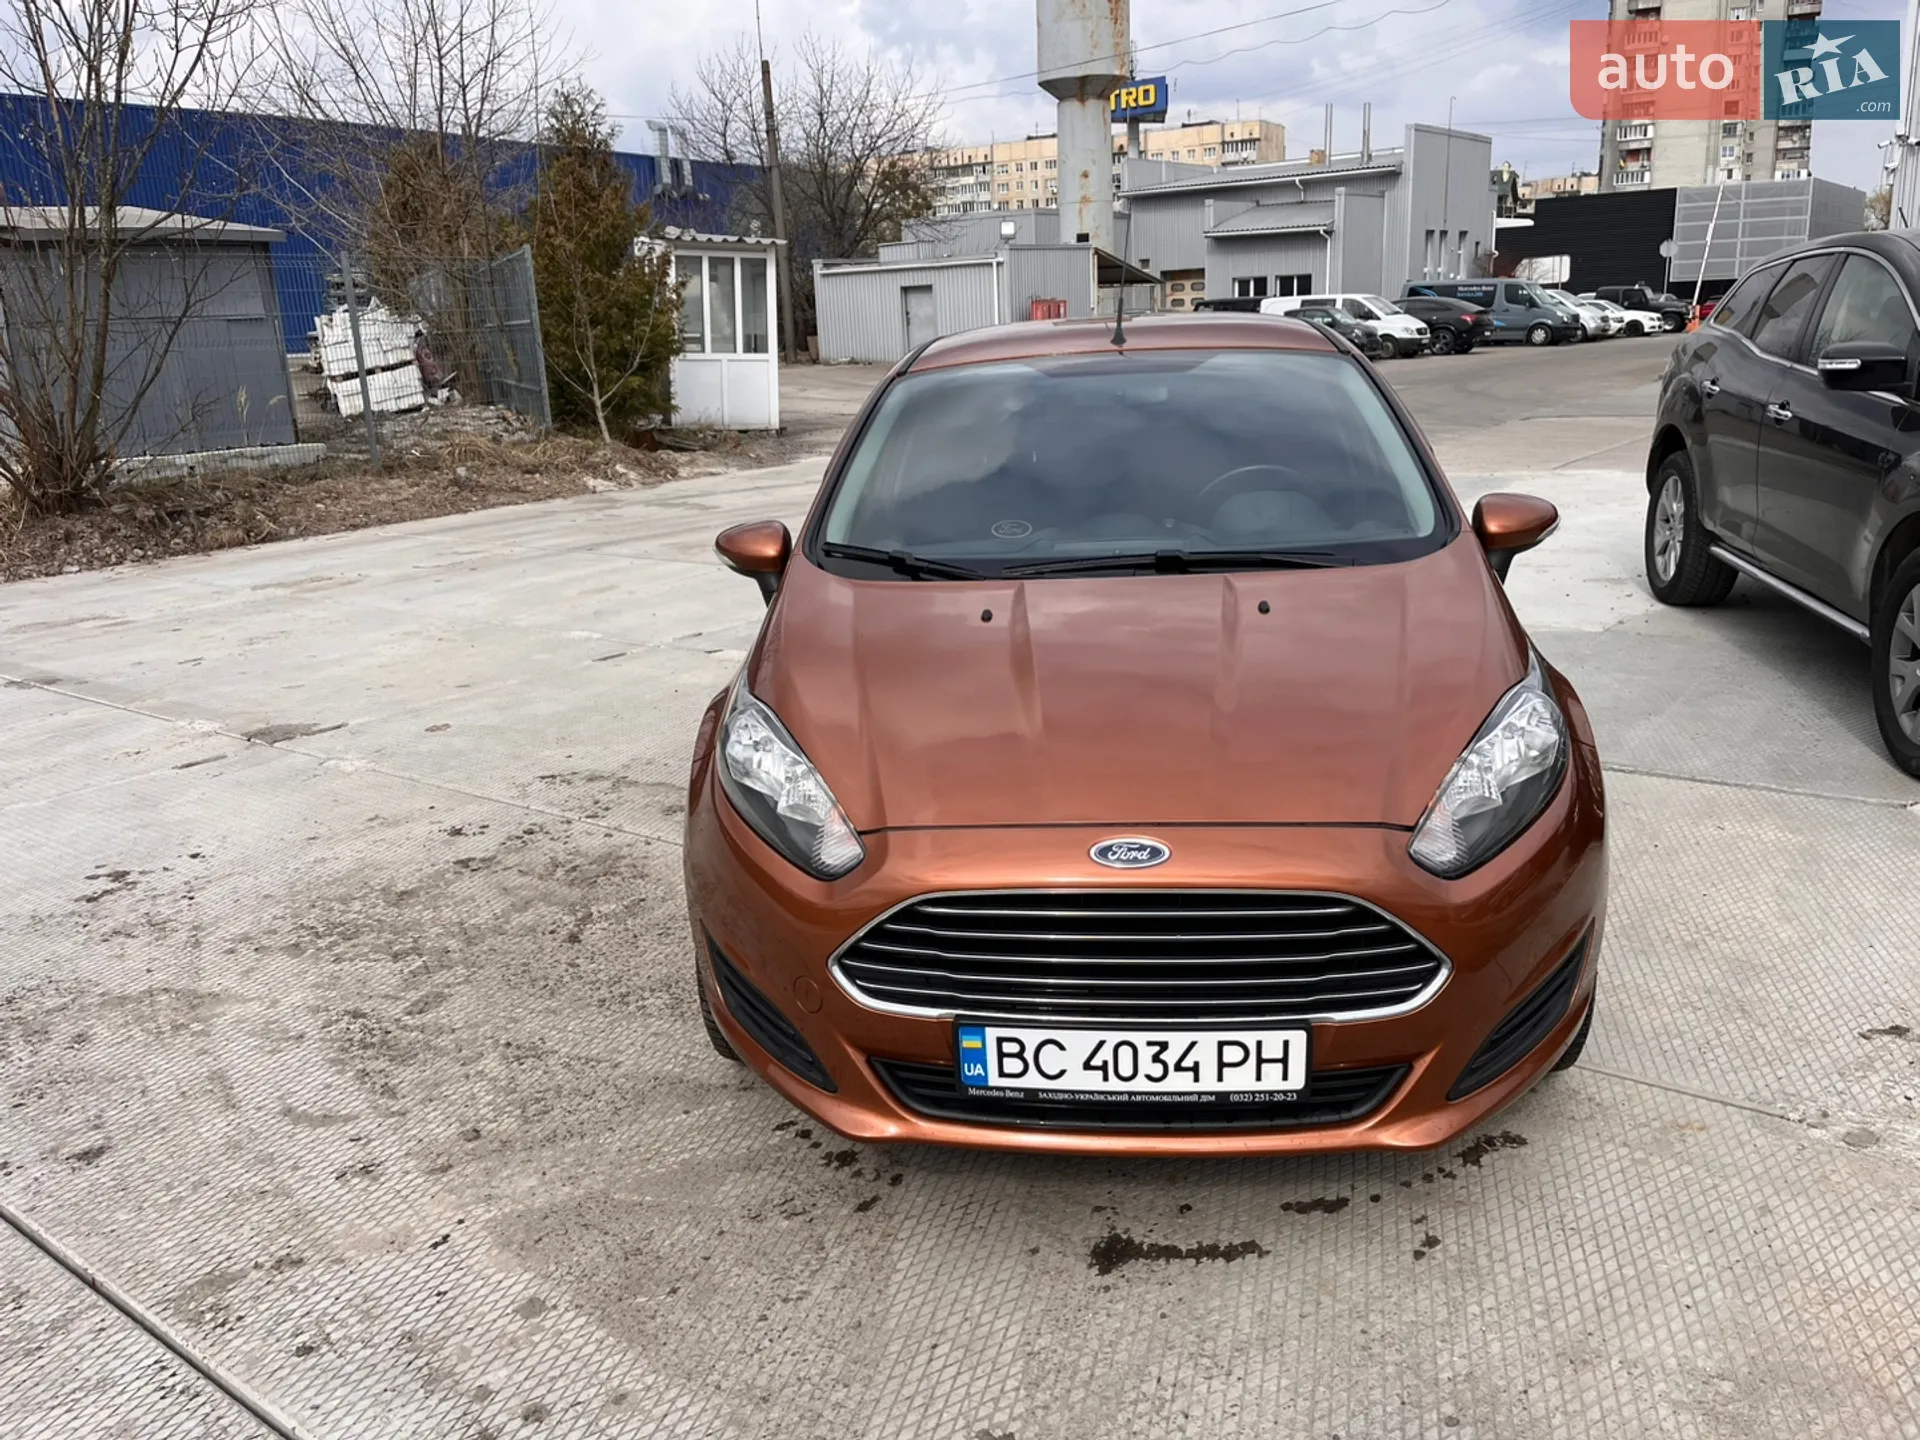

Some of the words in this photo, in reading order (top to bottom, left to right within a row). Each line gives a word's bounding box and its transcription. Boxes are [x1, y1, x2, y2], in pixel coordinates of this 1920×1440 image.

[1107, 842, 1151, 860] Ford
[995, 1036, 1067, 1081] BC
[1082, 1039, 1200, 1083] 4034
[1216, 1039, 1290, 1083] PH
[964, 1063, 985, 1077] UA
[1229, 1092, 1253, 1103] (032)
[1254, 1092, 1298, 1102] 251-20-23
